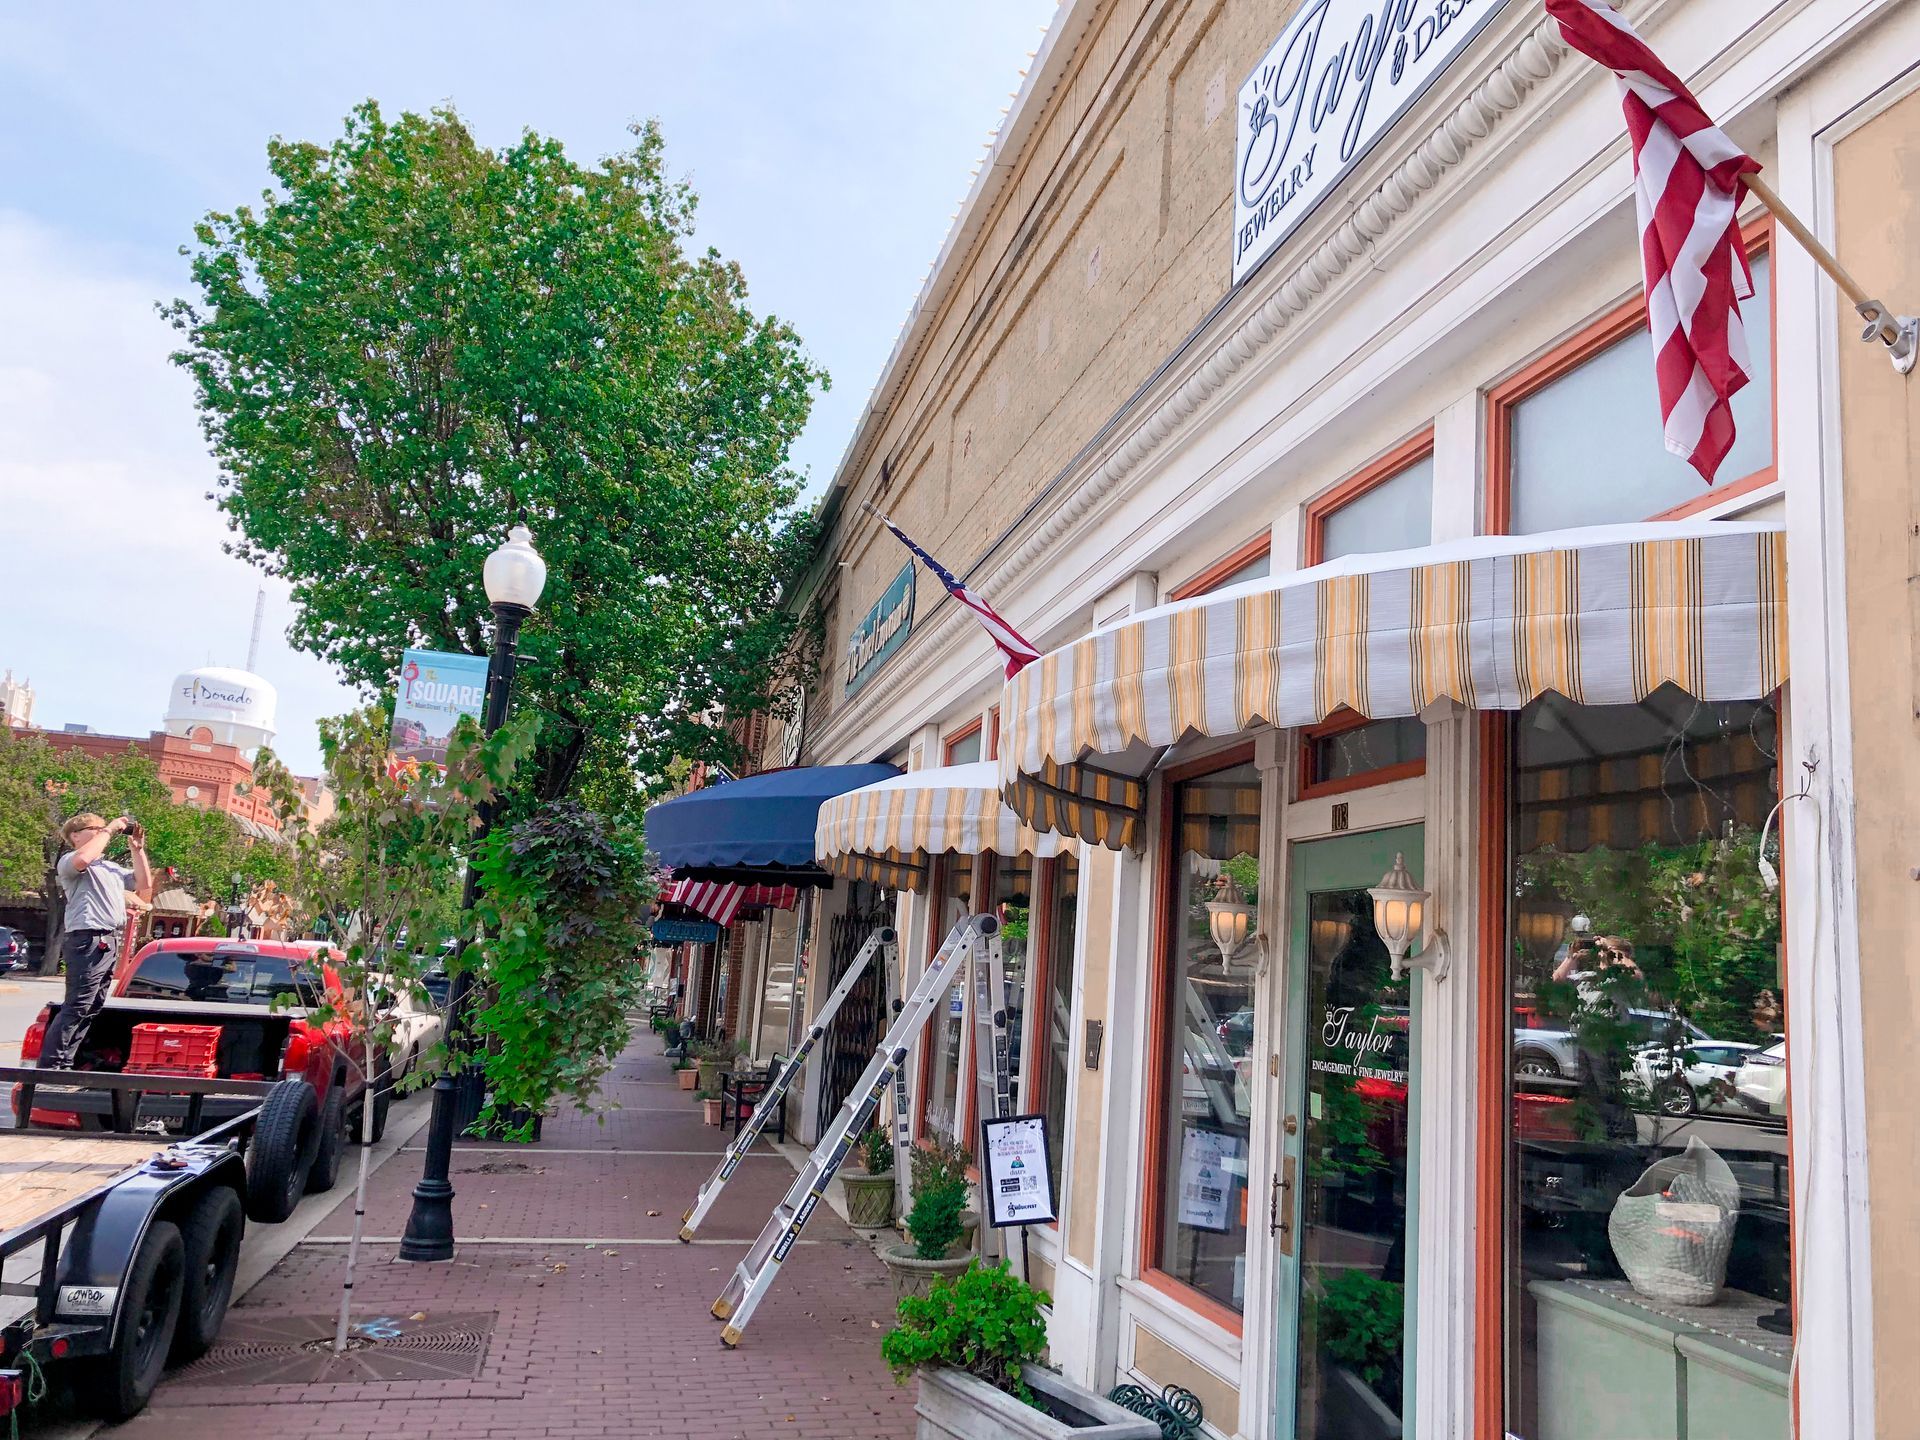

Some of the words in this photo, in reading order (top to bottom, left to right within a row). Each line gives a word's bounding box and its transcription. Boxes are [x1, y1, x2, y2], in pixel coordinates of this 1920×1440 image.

[1236, 142, 1317, 265] JEWELRY
[201, 685, 253, 705] Dorado
[412, 681, 483, 707] SQUARE
[1333, 804, 1348, 830] 103
[1322, 1005, 1393, 1067] Taylor
[1312, 1060, 1351, 1075] ENGAGEMENT
[1358, 1066, 1373, 1078] FINE
[1374, 1069, 1403, 1083] JEWELRY
[776, 1232, 795, 1260] GORILLA
[796, 1195, 816, 1224] LADDERS
[68, 1289, 105, 1302] COWBOY
